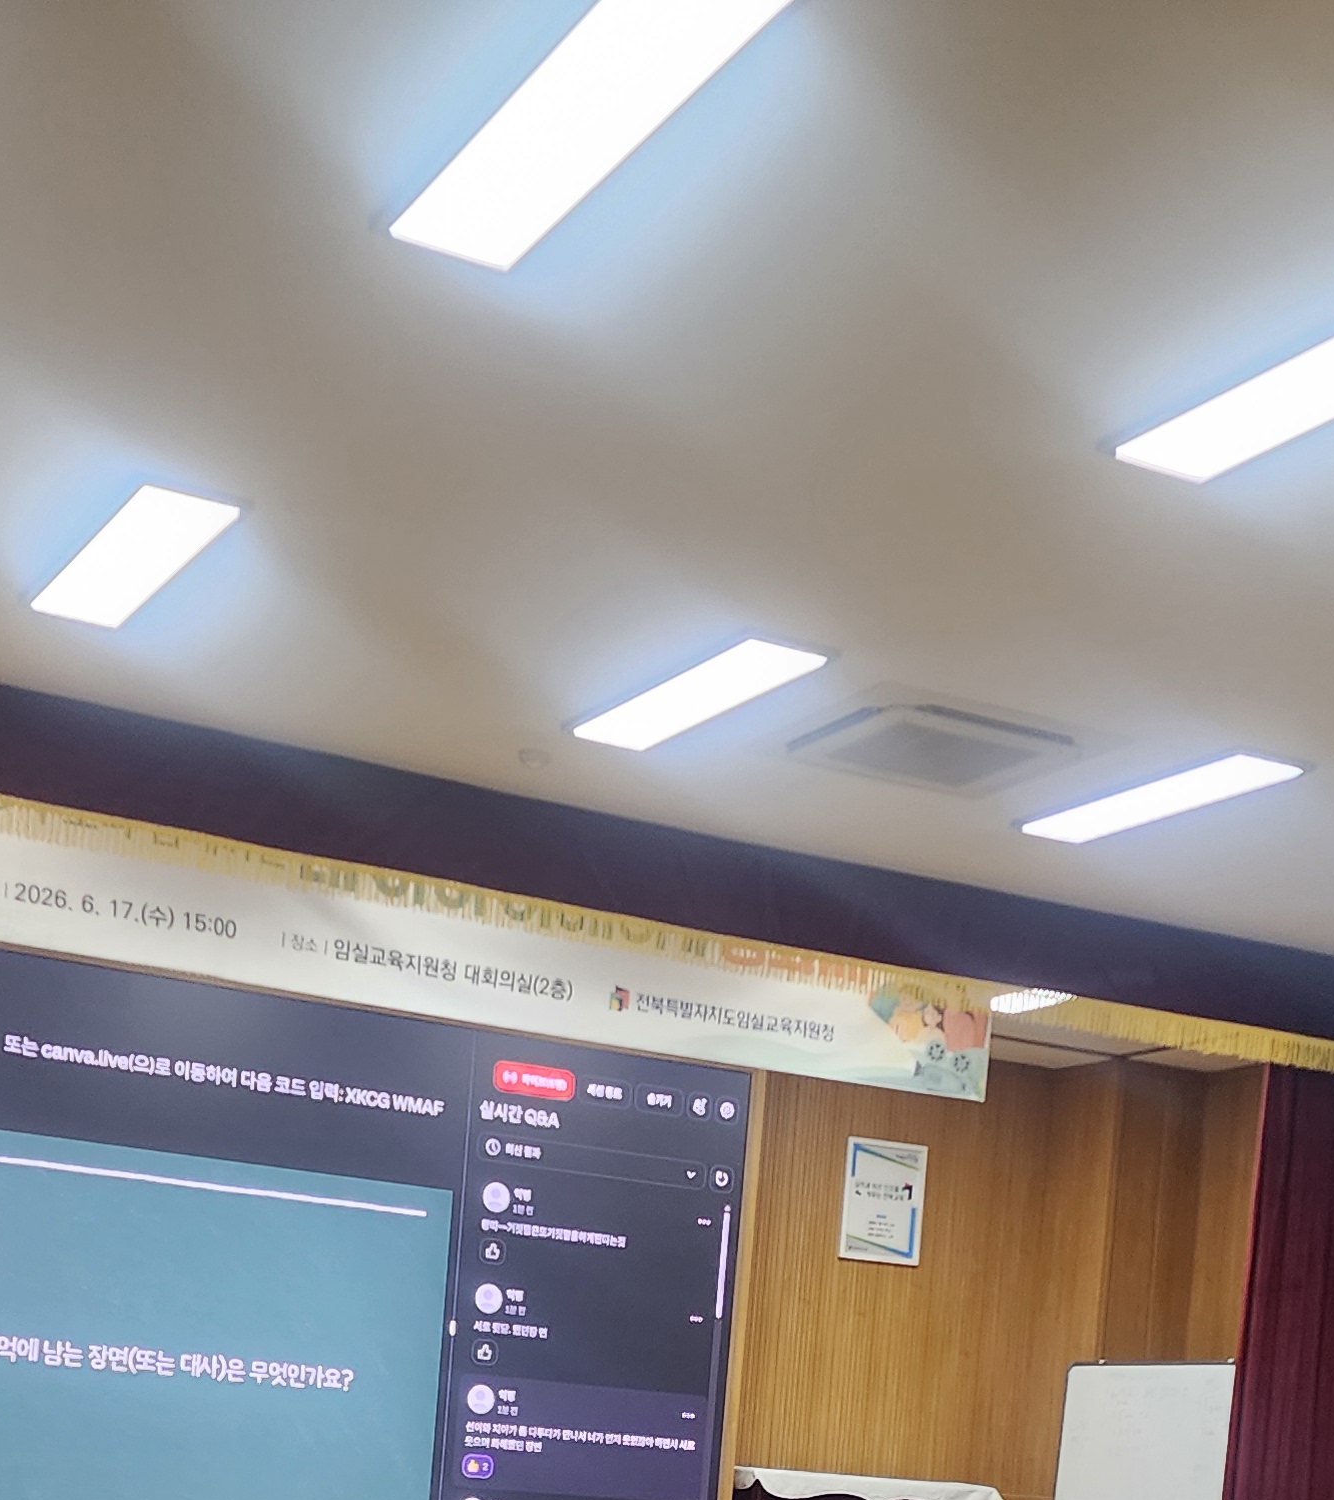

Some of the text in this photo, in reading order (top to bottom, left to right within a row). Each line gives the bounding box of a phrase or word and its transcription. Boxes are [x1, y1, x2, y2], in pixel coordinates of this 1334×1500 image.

[14, 882, 72, 912] 2026.
[81, 894, 100, 917] 6.
[109, 899, 175, 930] 17.(수)
[183, 911, 238, 939] 15:00
[334, 938, 458, 982] 임실교육지원청
[463, 963, 575, 1002] 대회의실(2층)
[3, 1034, 40, 1058] 또는
[41, 1043, 171, 1076] canva.live(으)로
[174, 1059, 238, 1087] 이동하여
[240, 1069, 273, 1093] 다음
[274, 1076, 306, 1097] 코드
[344, 1086, 391, 1111] XKCG
[392, 1094, 445, 1117] WMAF
[479, 1100, 561, 1129] 실시간 Q&A
[42, 1340, 84, 1368] 남는
[88, 1344, 176, 1376] 장면(또는
[180, 1353, 246, 1382] 대사)은
[249, 1360, 354, 1392] 무엇인가요?
